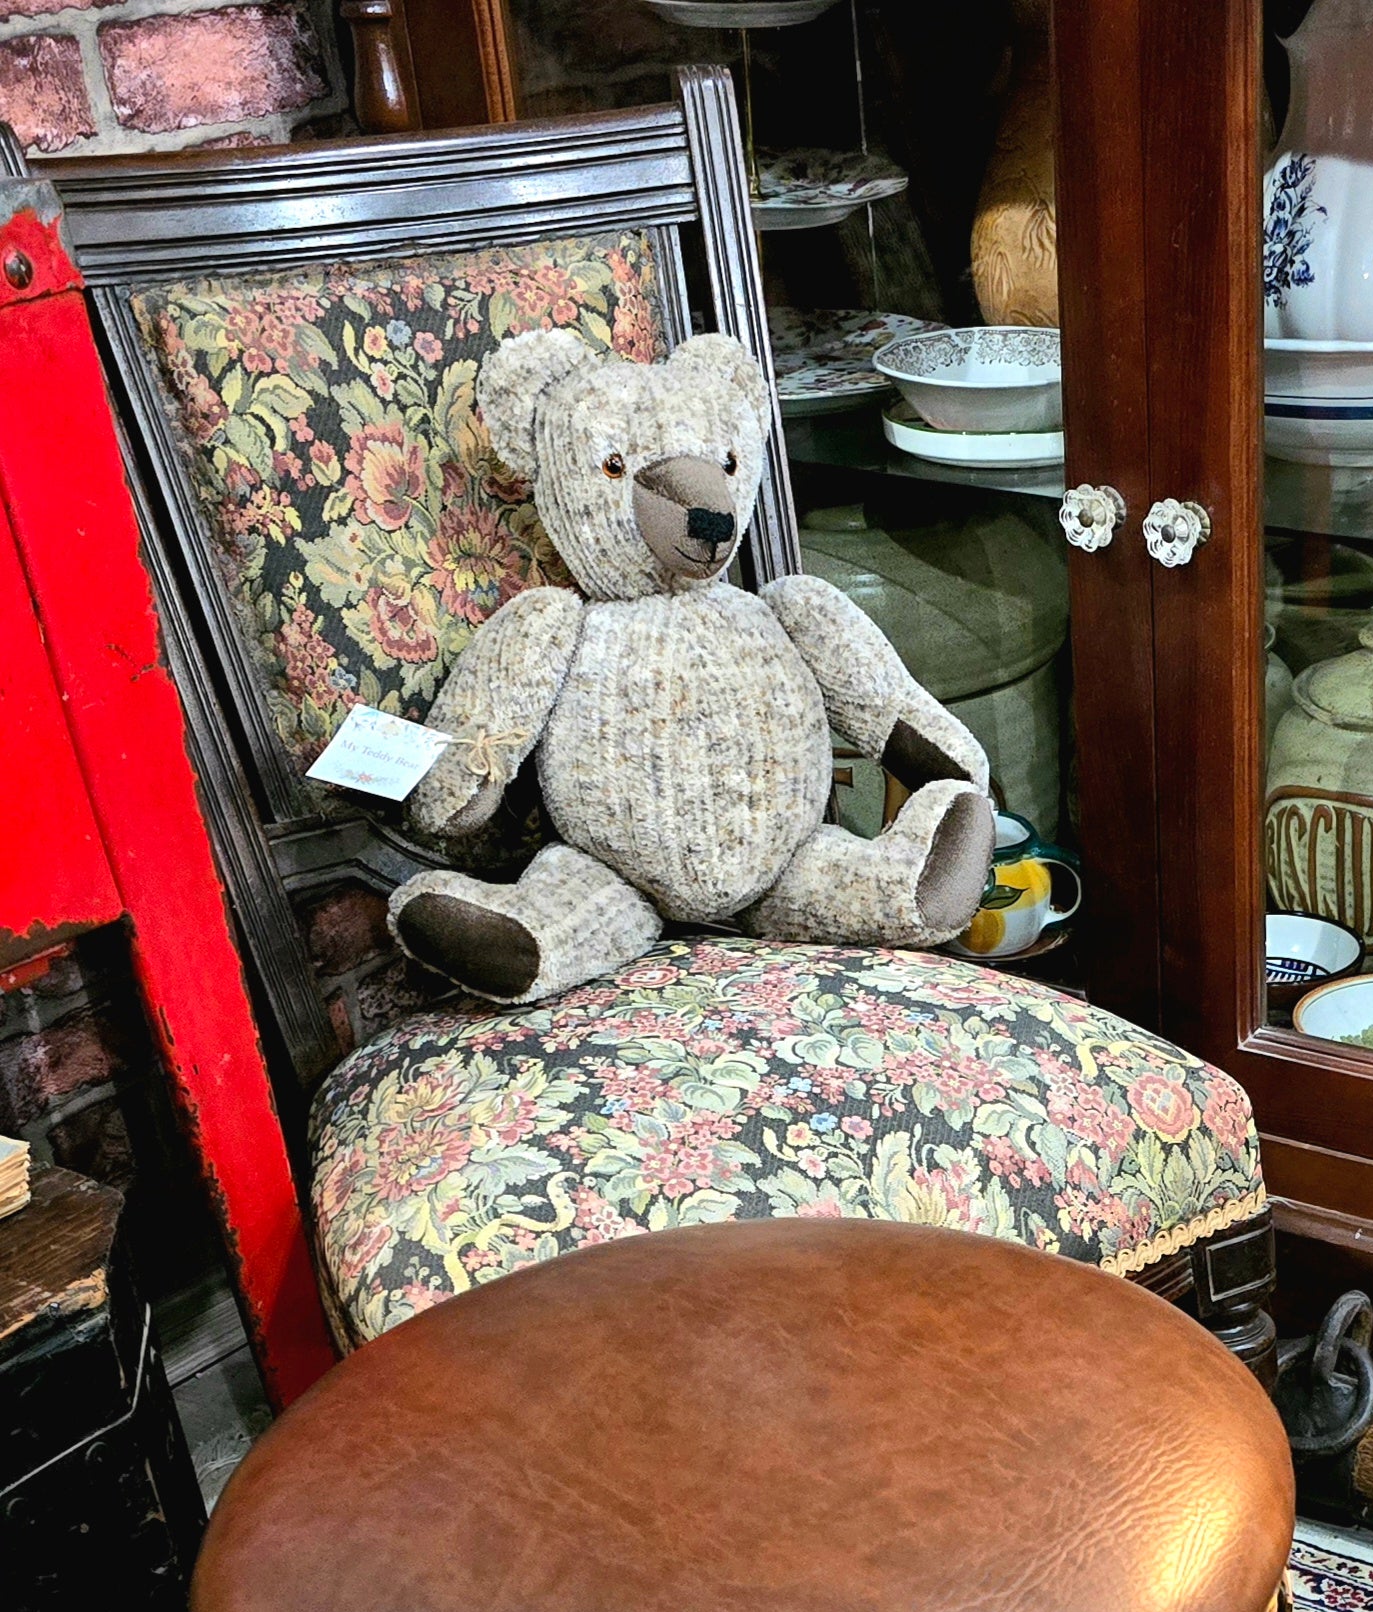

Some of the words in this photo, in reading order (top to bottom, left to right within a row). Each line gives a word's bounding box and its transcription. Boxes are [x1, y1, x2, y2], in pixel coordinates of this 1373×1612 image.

[341, 739, 358, 751] My
[362, 745, 393, 762] Teddy
[395, 756, 419, 769] Bear
